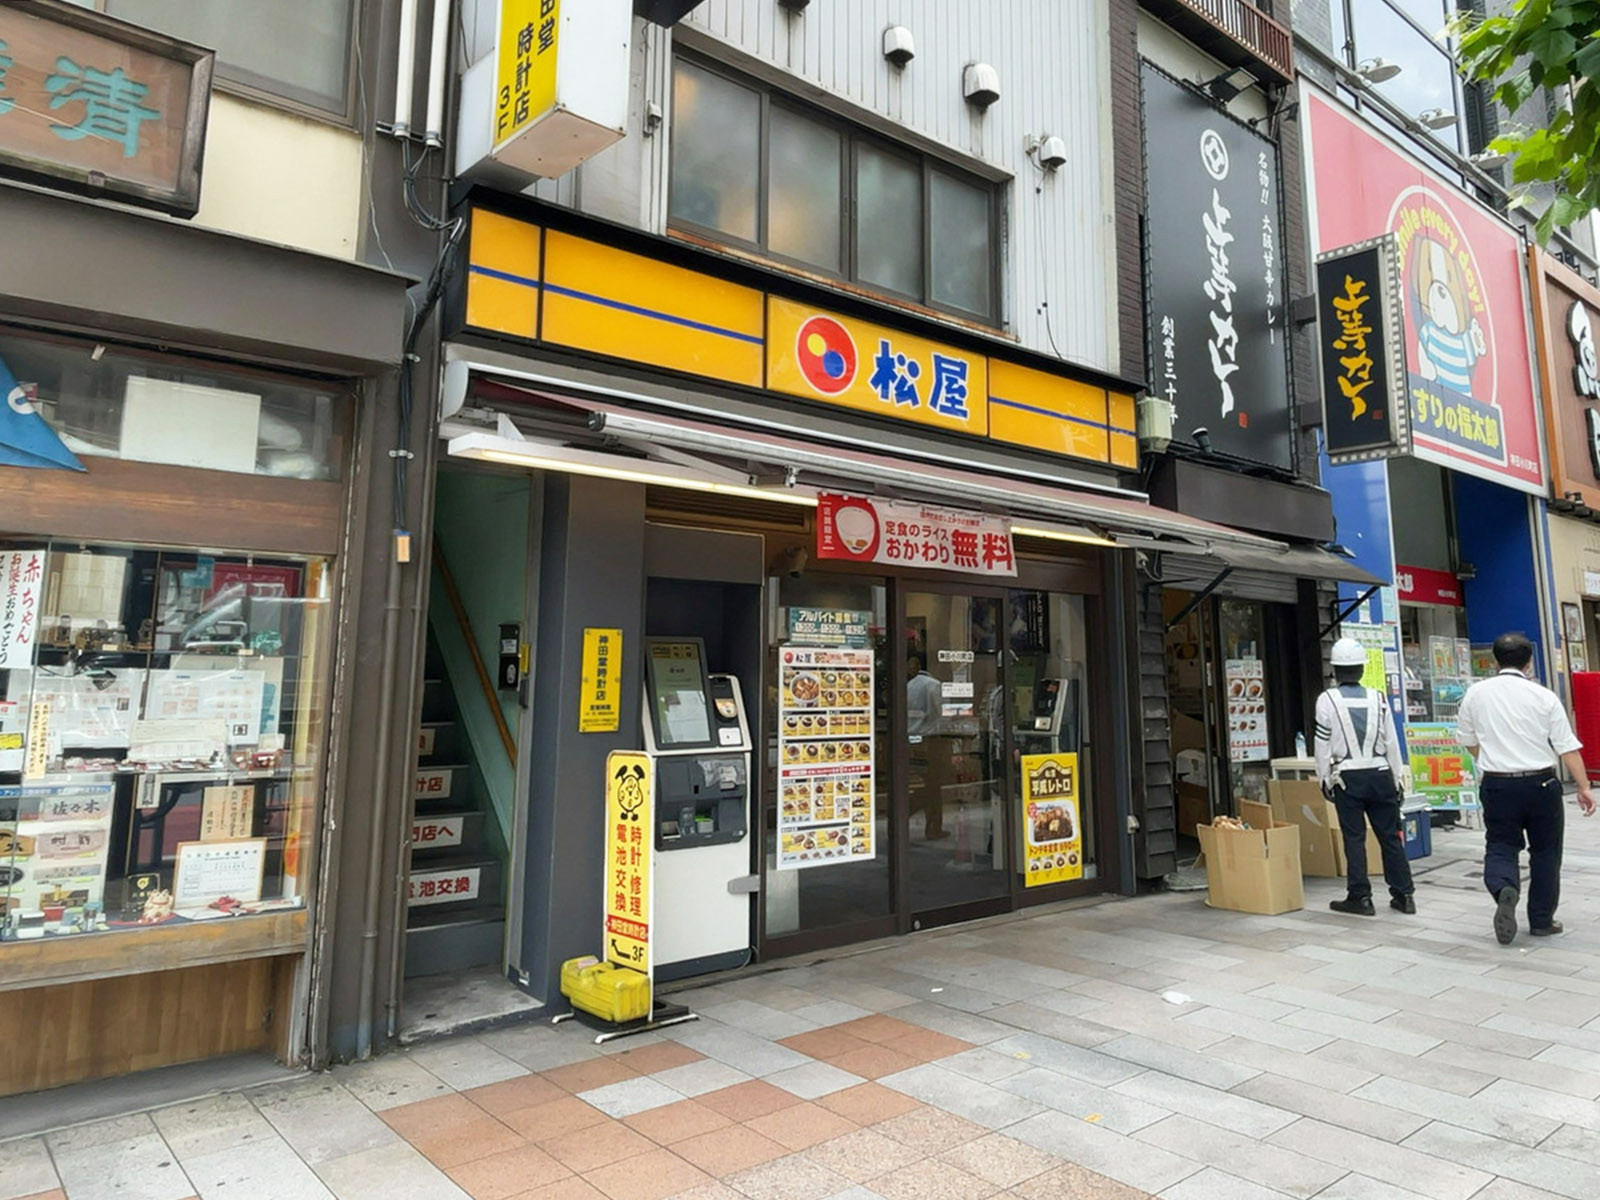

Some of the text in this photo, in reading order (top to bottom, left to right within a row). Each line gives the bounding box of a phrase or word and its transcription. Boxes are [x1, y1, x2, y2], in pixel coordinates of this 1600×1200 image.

[511, 21, 535, 128] 時計店
[868, 338, 970, 420] 松屋
[1411, 387, 1500, 450] すりの福太郎
[884, 520, 950, 542] 定食のライス
[886, 538, 950, 564] おかわり
[951, 529, 1013, 571] 無料
[16, 553, 41, 644] 赤ちゃん
[614, 823, 627, 913] 電池交換
[632, 945, 644, 963] 3F
